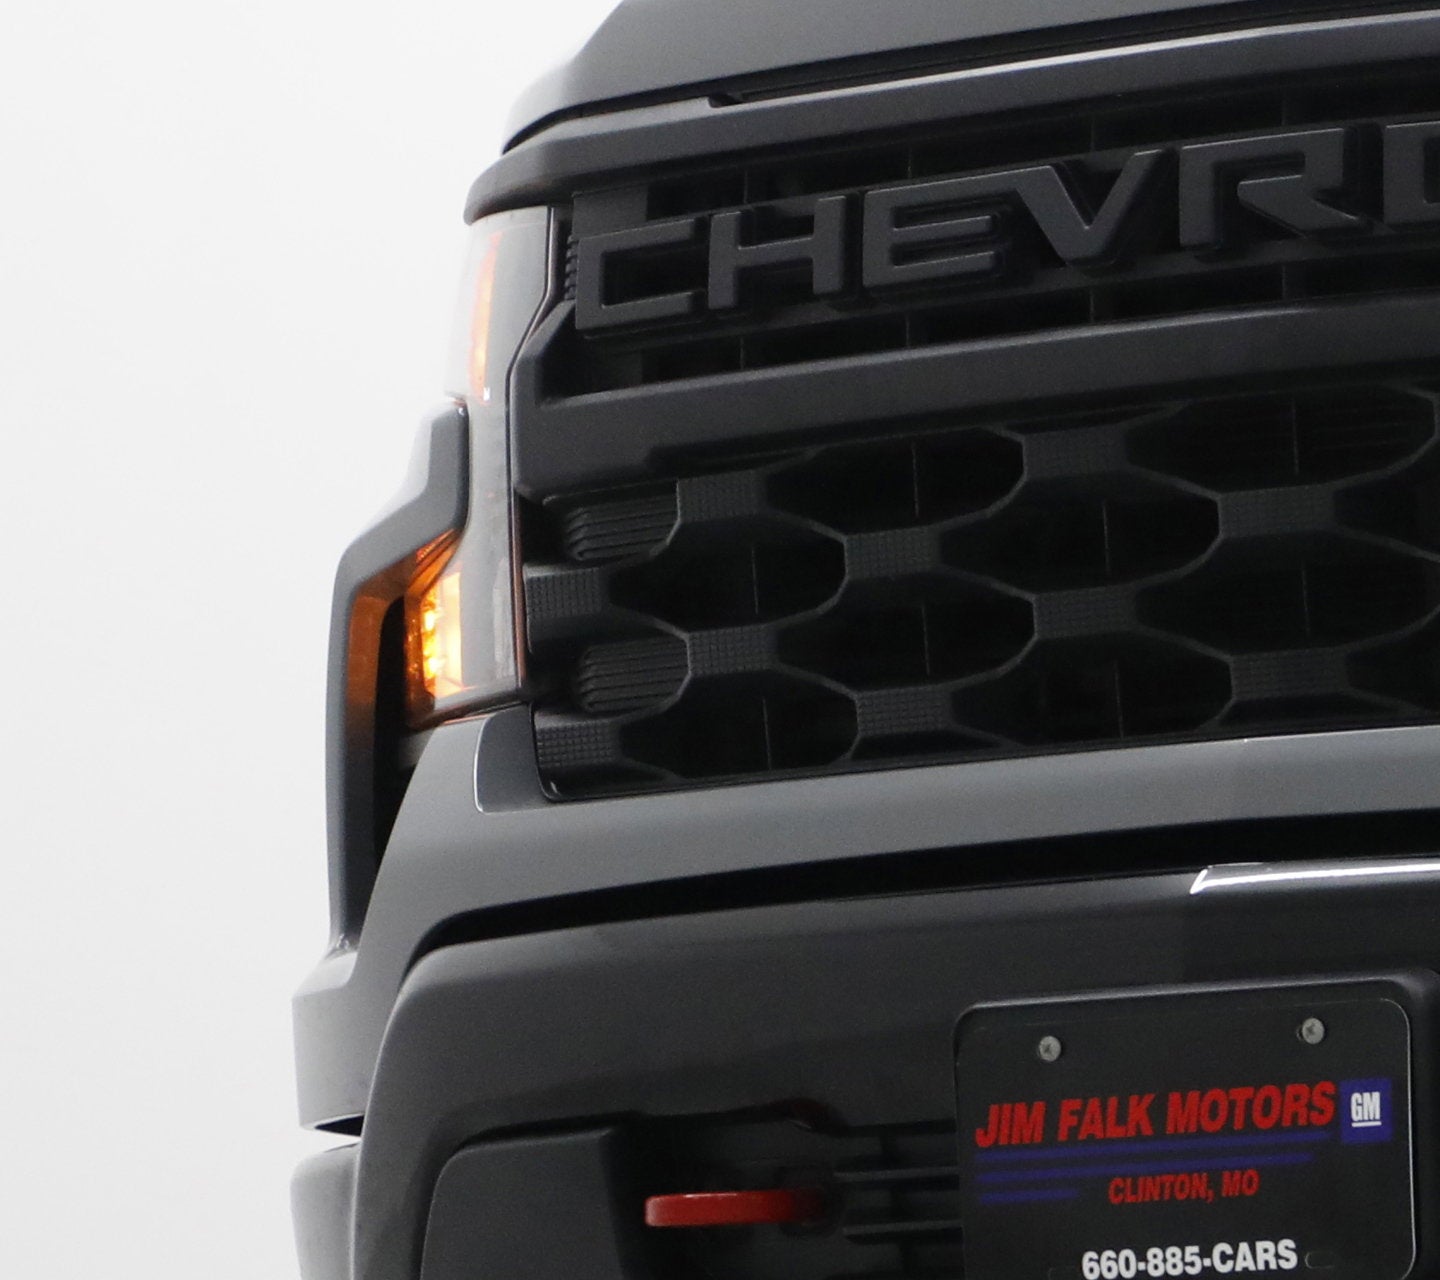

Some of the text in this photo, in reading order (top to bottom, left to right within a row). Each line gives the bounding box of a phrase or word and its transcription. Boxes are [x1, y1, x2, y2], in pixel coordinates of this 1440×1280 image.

[975, 1081, 1336, 1148] JIM FALK MOTORS
[1350, 1091, 1382, 1123] GM
[1108, 1168, 1260, 1205] CLINTON, MO
